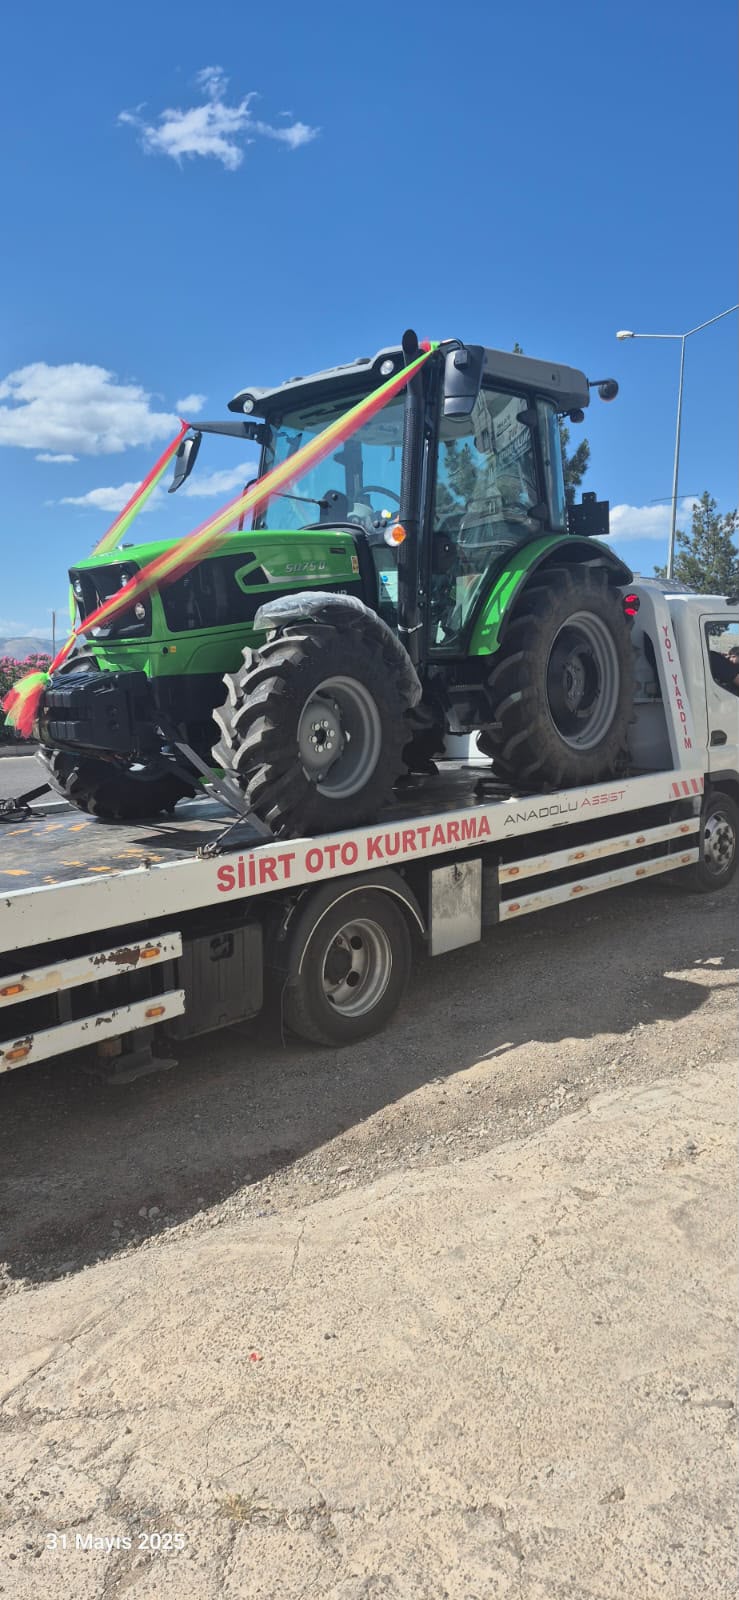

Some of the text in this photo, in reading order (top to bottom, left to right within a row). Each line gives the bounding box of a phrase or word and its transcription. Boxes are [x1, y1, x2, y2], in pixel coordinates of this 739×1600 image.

[662, 625, 674, 663] YOL
[672, 674, 692, 749] YARDIM
[503, 801, 578, 826] ANADOLU
[305, 841, 359, 873] OTO
[366, 815, 492, 861] KURTARMA
